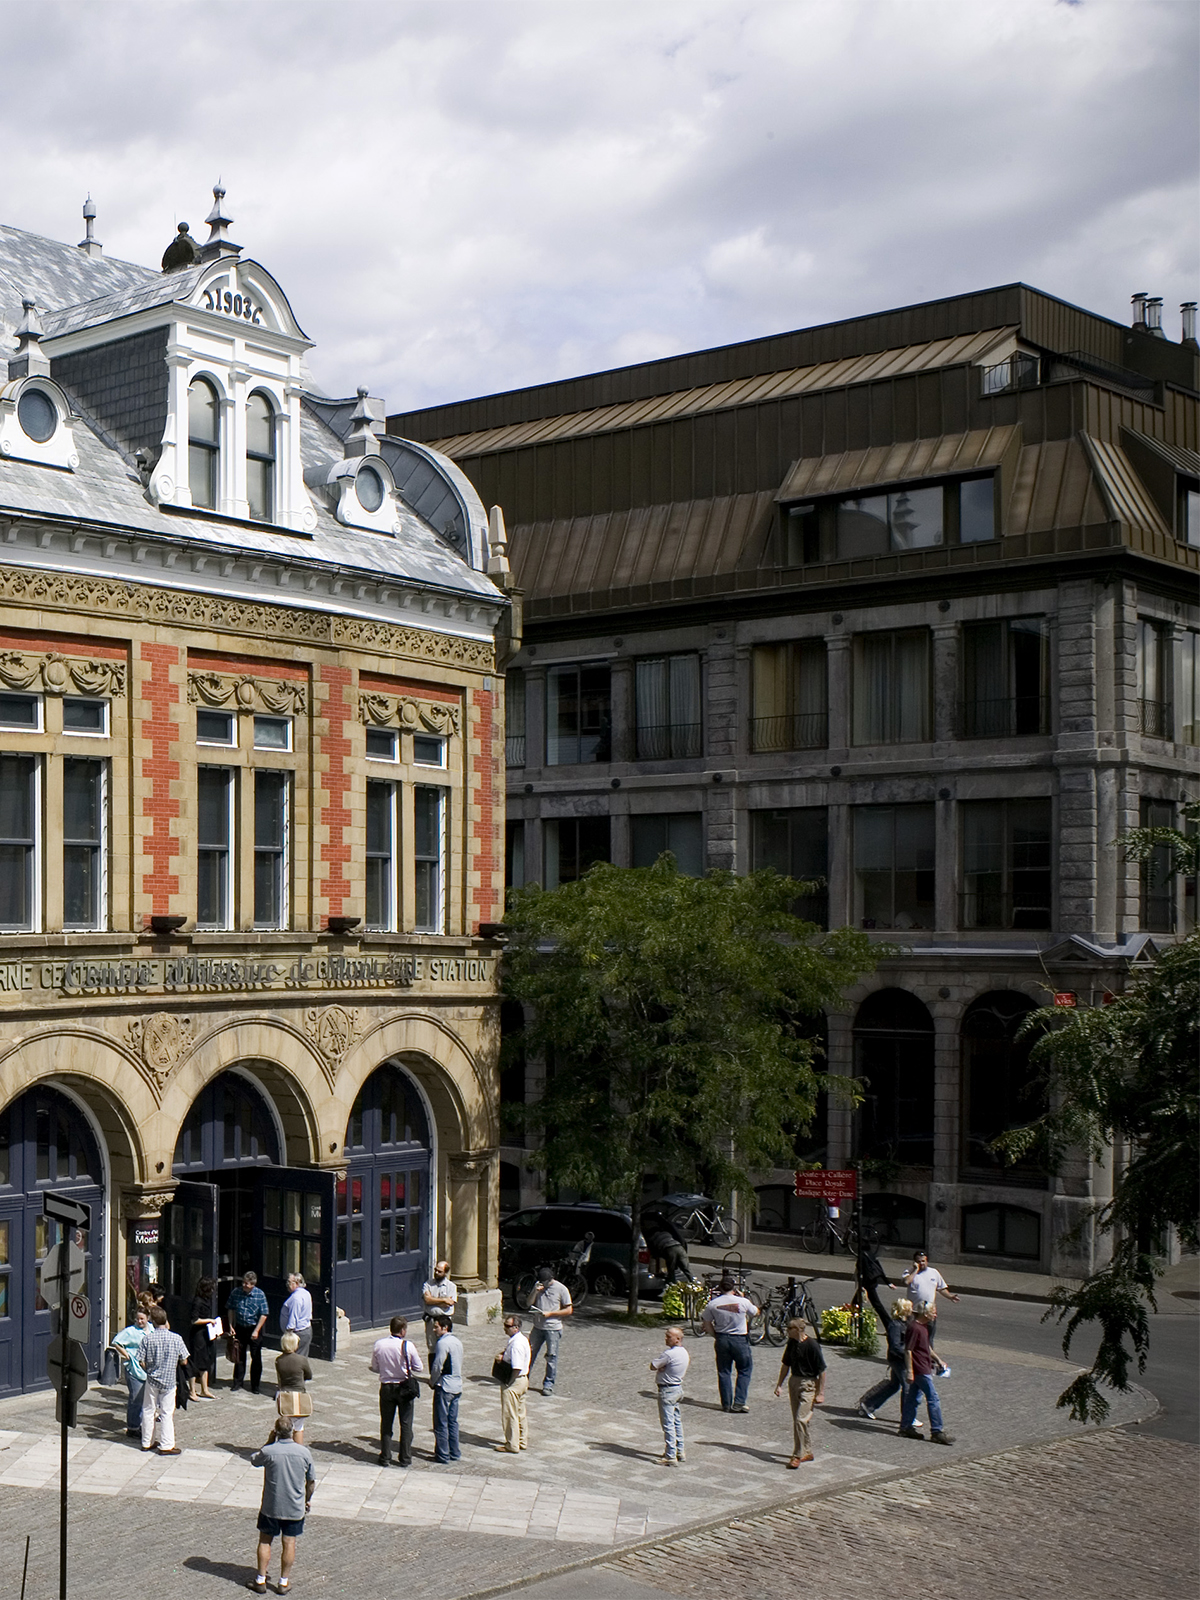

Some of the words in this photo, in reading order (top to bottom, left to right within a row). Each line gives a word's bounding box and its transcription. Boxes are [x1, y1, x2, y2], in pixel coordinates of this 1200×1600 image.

[216, 288, 252, 319] 1903
[65, 959, 153, 988] Centre
[166, 956, 278, 986] d'histoire
[289, 955, 314, 982] de
[431, 960, 487, 982] STATION
[805, 1179, 823, 1187] Place
[825, 1179, 846, 1189] Royale
